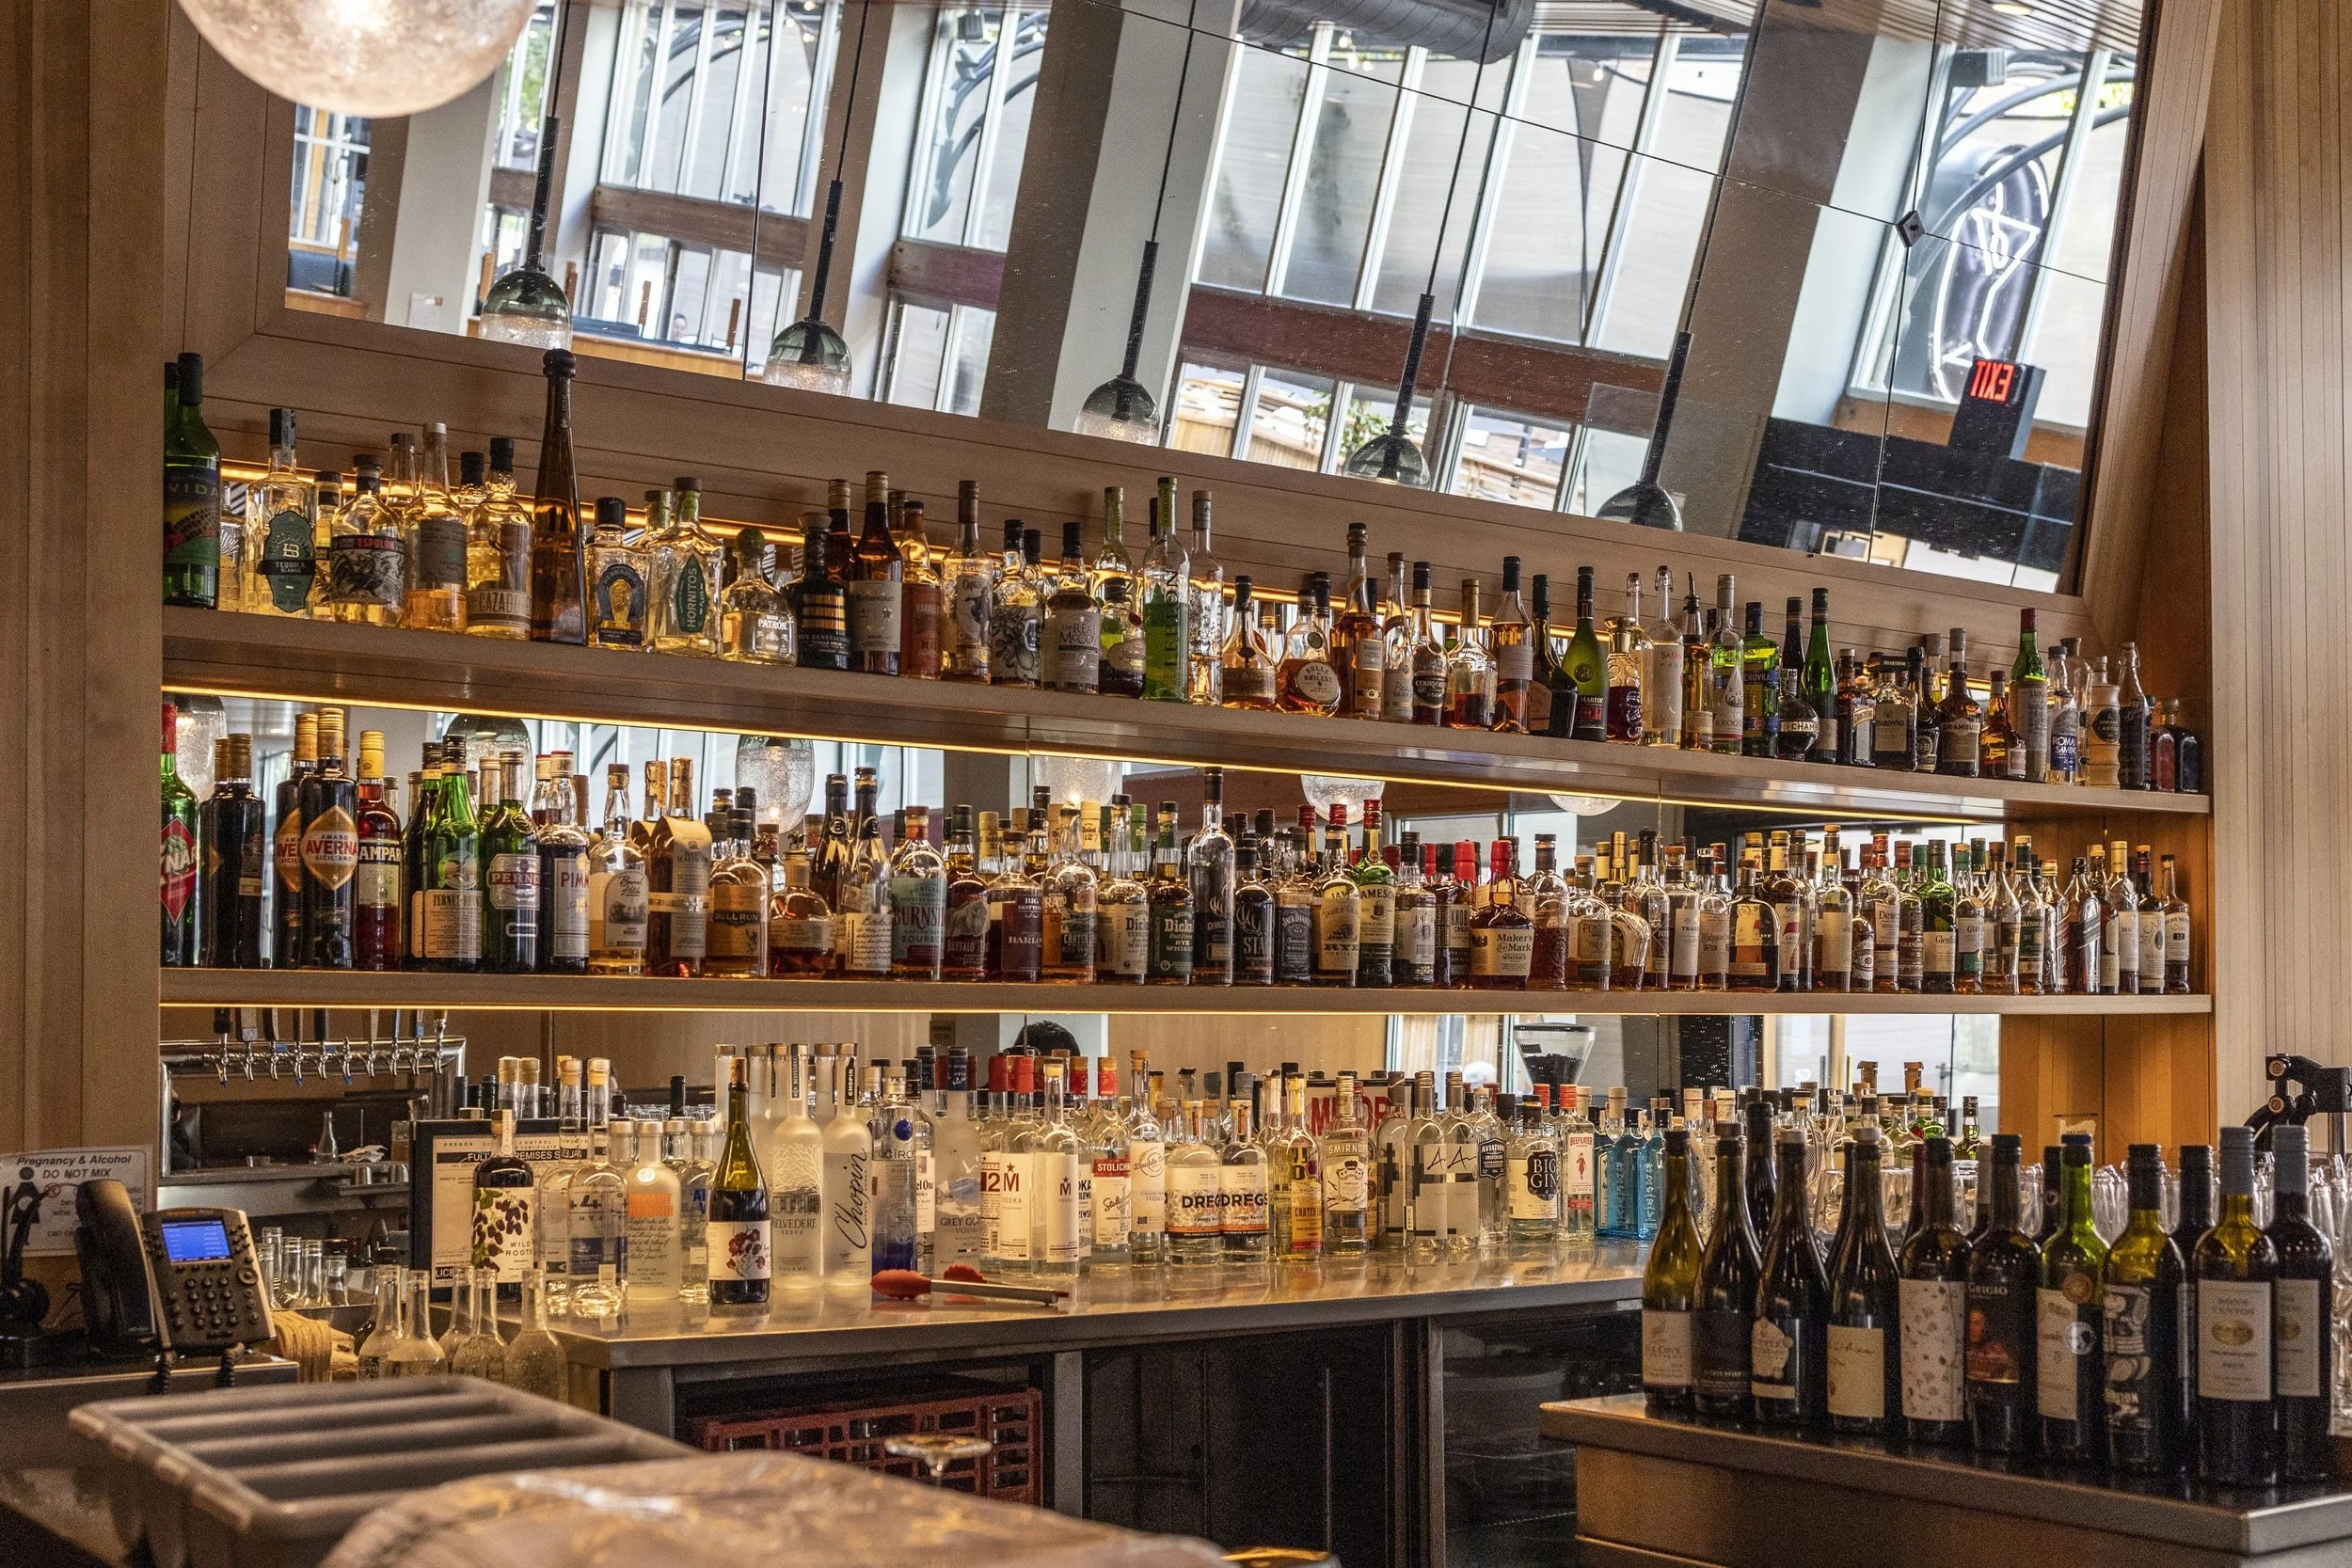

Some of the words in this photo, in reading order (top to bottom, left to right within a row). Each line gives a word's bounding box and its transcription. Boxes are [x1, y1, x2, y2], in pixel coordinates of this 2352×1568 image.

[169, 480, 219, 497] VIDA
[686, 567, 697, 628] HORNITOS
[1743, 673, 1772, 682] EROVKA
[306, 841, 358, 855] AVERNA
[359, 845, 402, 861] AMPAR
[713, 912, 739, 921] BULL
[739, 912, 759, 922] RUN
[1497, 933, 1533, 942] Maker's
[1243, 936, 1264, 955] STA
[1508, 942, 1532, 952] Mark
[1569, 1136, 1593, 1146] BEEFEATER
[17, 1157, 75, 1166] Pregnancy
[78, 1156, 86, 1164] &
[92, 1155, 132, 1164] Alcohol
[1534, 1158, 1555, 1174] BIG
[42, 1170, 60, 1179] DO
[64, 1169, 88, 1178] NOT
[90, 1168, 111, 1178] MIX
[1003, 1173, 1020, 1192] M
[1531, 1173, 1557, 1189] GIN
[1059, 1182, 1072, 1196] M
[834, 1147, 870, 1249] Chopin
[771, 1218, 817, 1229] BELVEDERE
[940, 1217, 962, 1227] GREY
